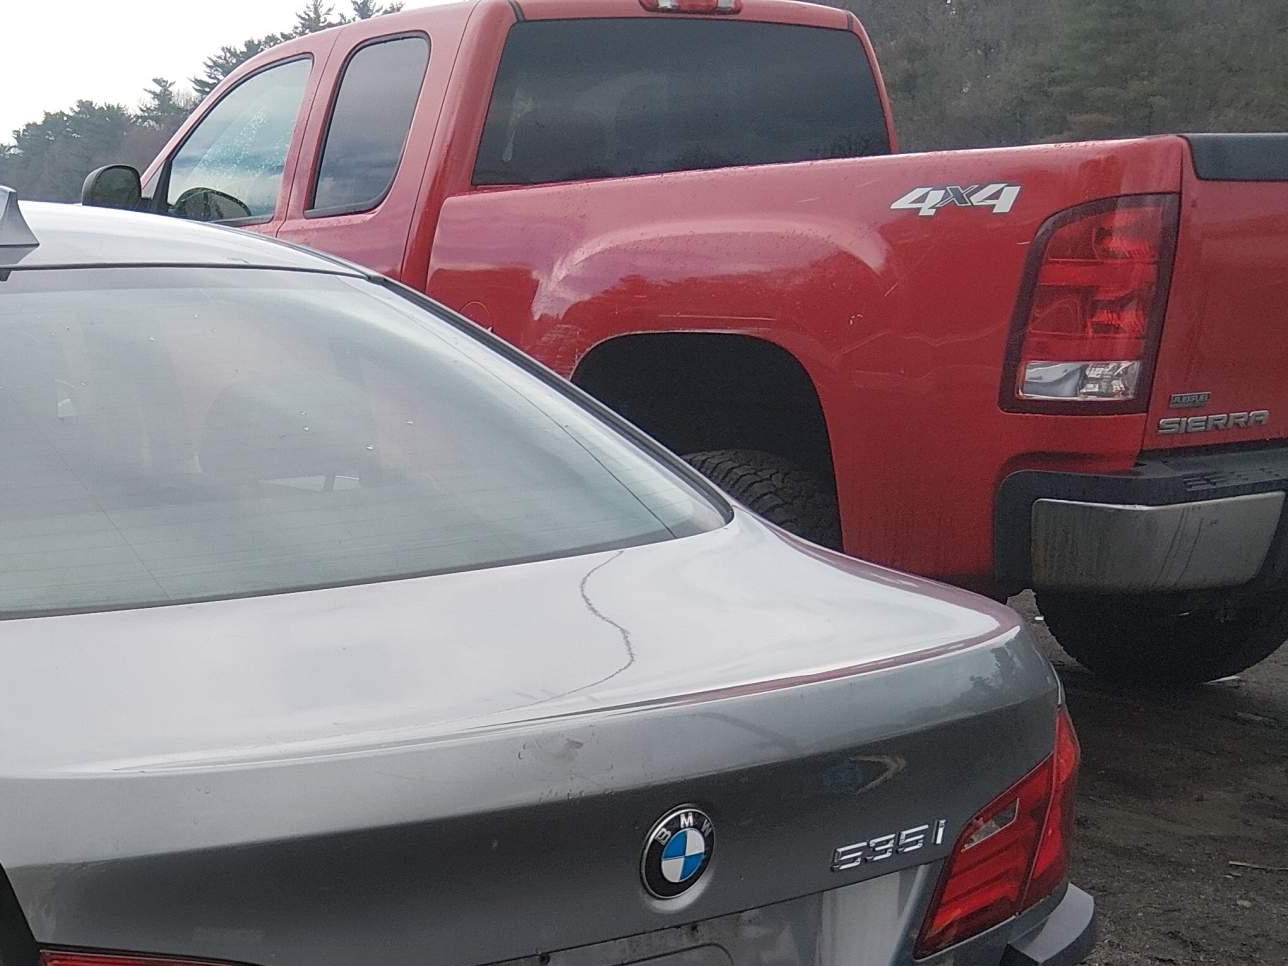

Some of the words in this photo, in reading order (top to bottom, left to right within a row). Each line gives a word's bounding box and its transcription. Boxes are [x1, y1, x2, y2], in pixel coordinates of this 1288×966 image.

[1157, 409, 1271, 434] SIERRA
[657, 813, 712, 845] BMW
[830, 818, 948, 873] 535i
